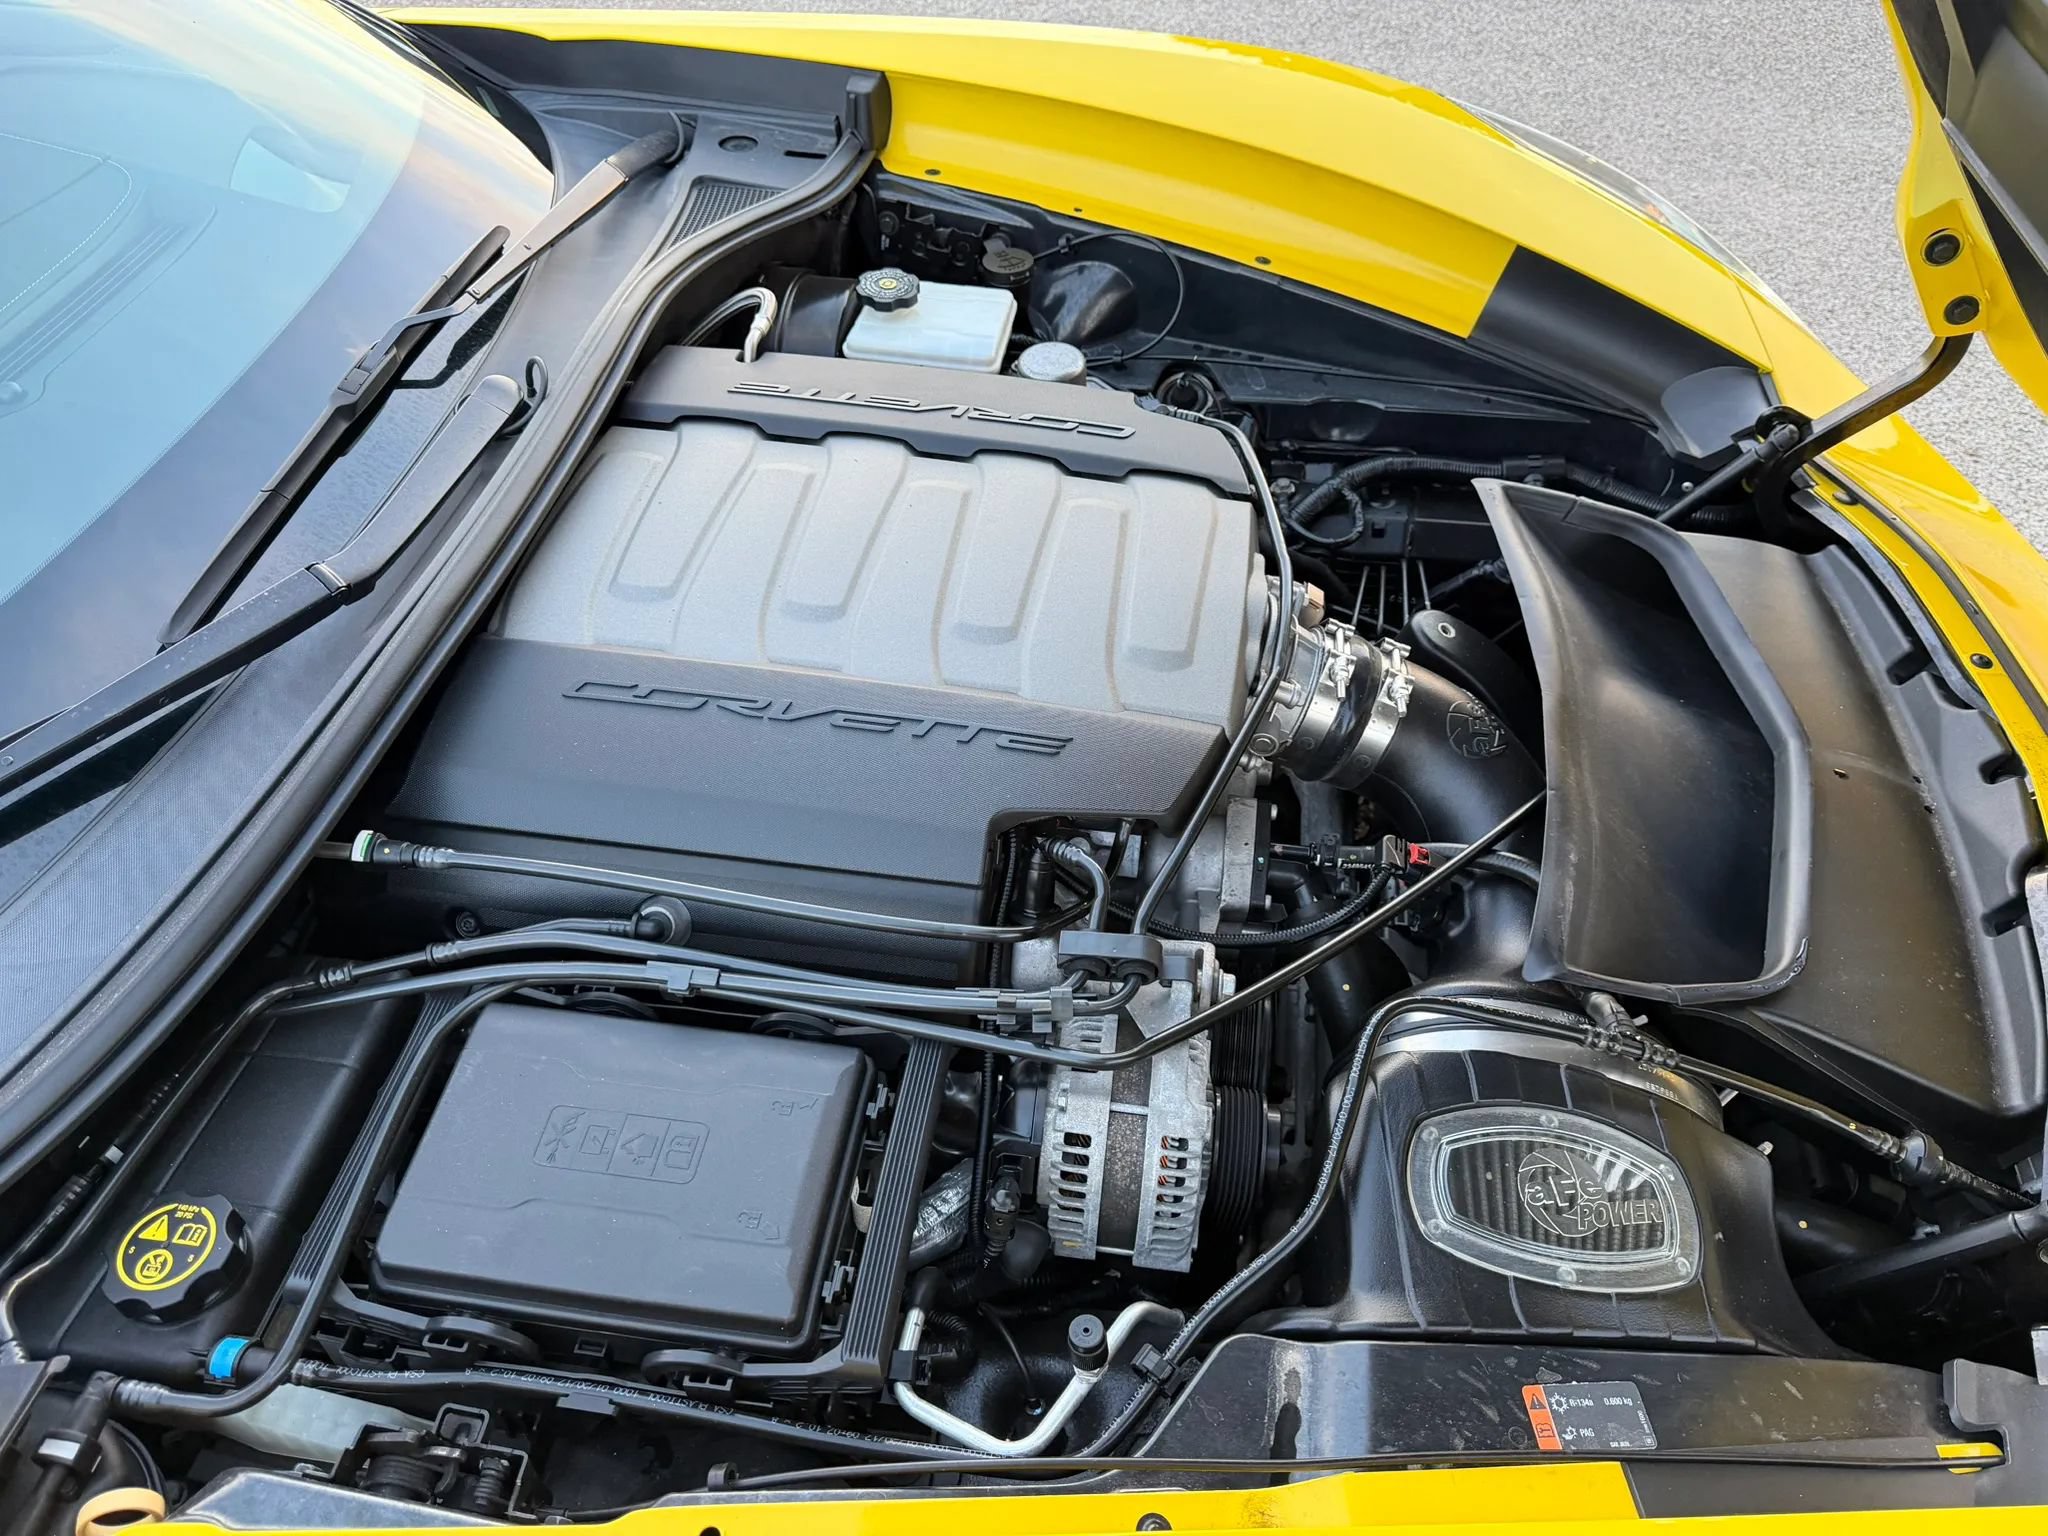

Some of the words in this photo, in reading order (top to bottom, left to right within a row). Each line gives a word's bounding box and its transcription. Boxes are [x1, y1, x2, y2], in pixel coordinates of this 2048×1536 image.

[728, 381, 1137, 440] CORVETTE
[561, 680, 1074, 756] CORVETTE
[1577, 1200, 1663, 1230] POWER
[1201, 1268, 1249, 1311] PLASTICOOL
[613, 1386, 639, 1397] 1000
[648, 1391, 708, 1410] PLASTICOOL
[1569, 1398, 1594, 1407] R-134a
[1623, 1396, 1633, 1406] kg
[1580, 1428, 1595, 1437] PAG
